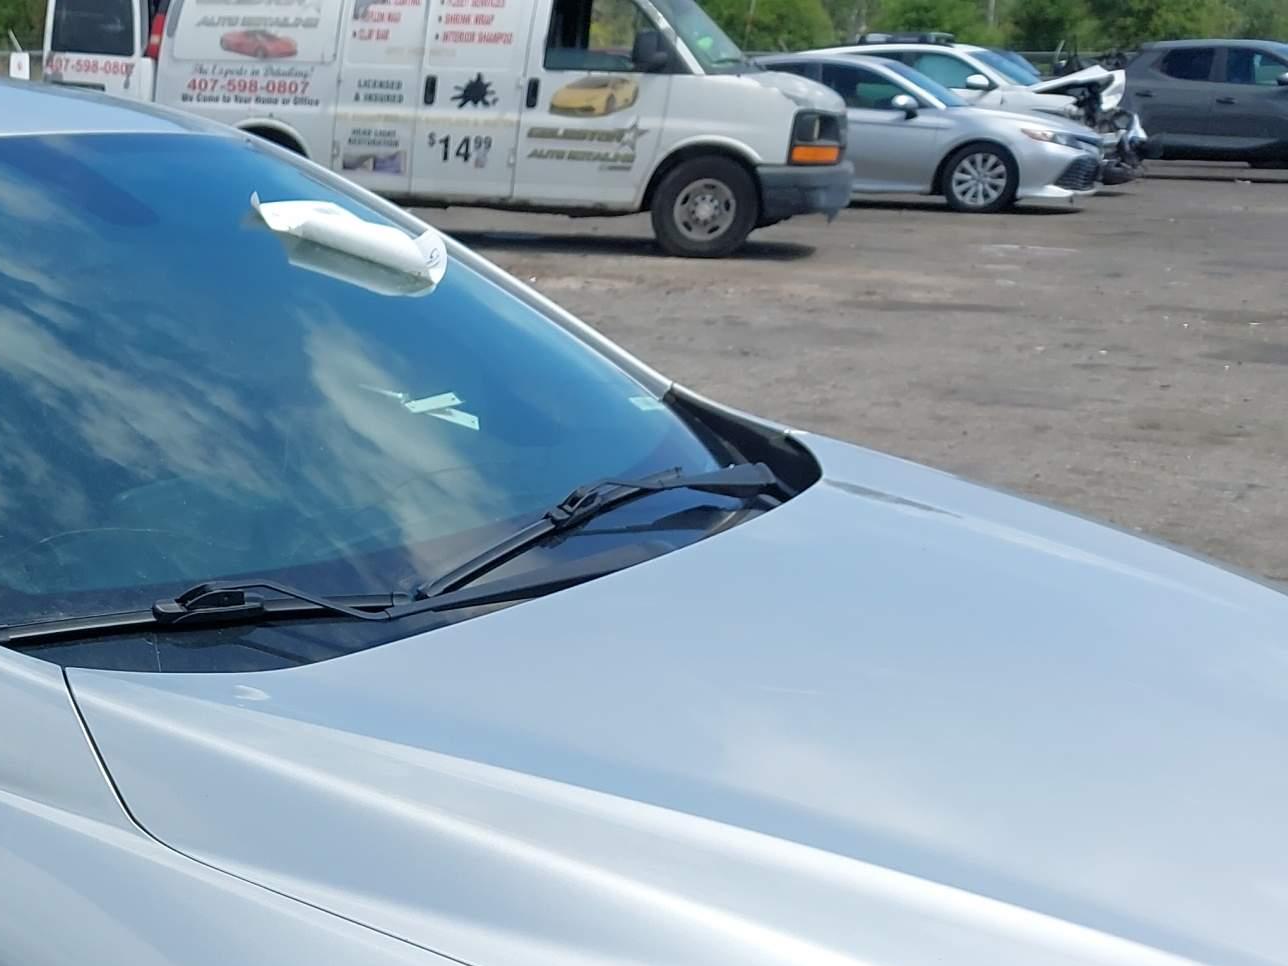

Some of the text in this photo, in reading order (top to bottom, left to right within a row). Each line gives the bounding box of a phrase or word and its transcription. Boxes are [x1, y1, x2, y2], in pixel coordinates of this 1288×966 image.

[187, 78, 310, 95] 407-598-0807
[357, 79, 403, 90] LICENSED
[196, 92, 219, 104] Come
[221, 93, 231, 104] to
[233, 94, 253, 105] Your
[255, 95, 280, 106] Home
[281, 97, 291, 106] or
[363, 93, 405, 105] INSURED
